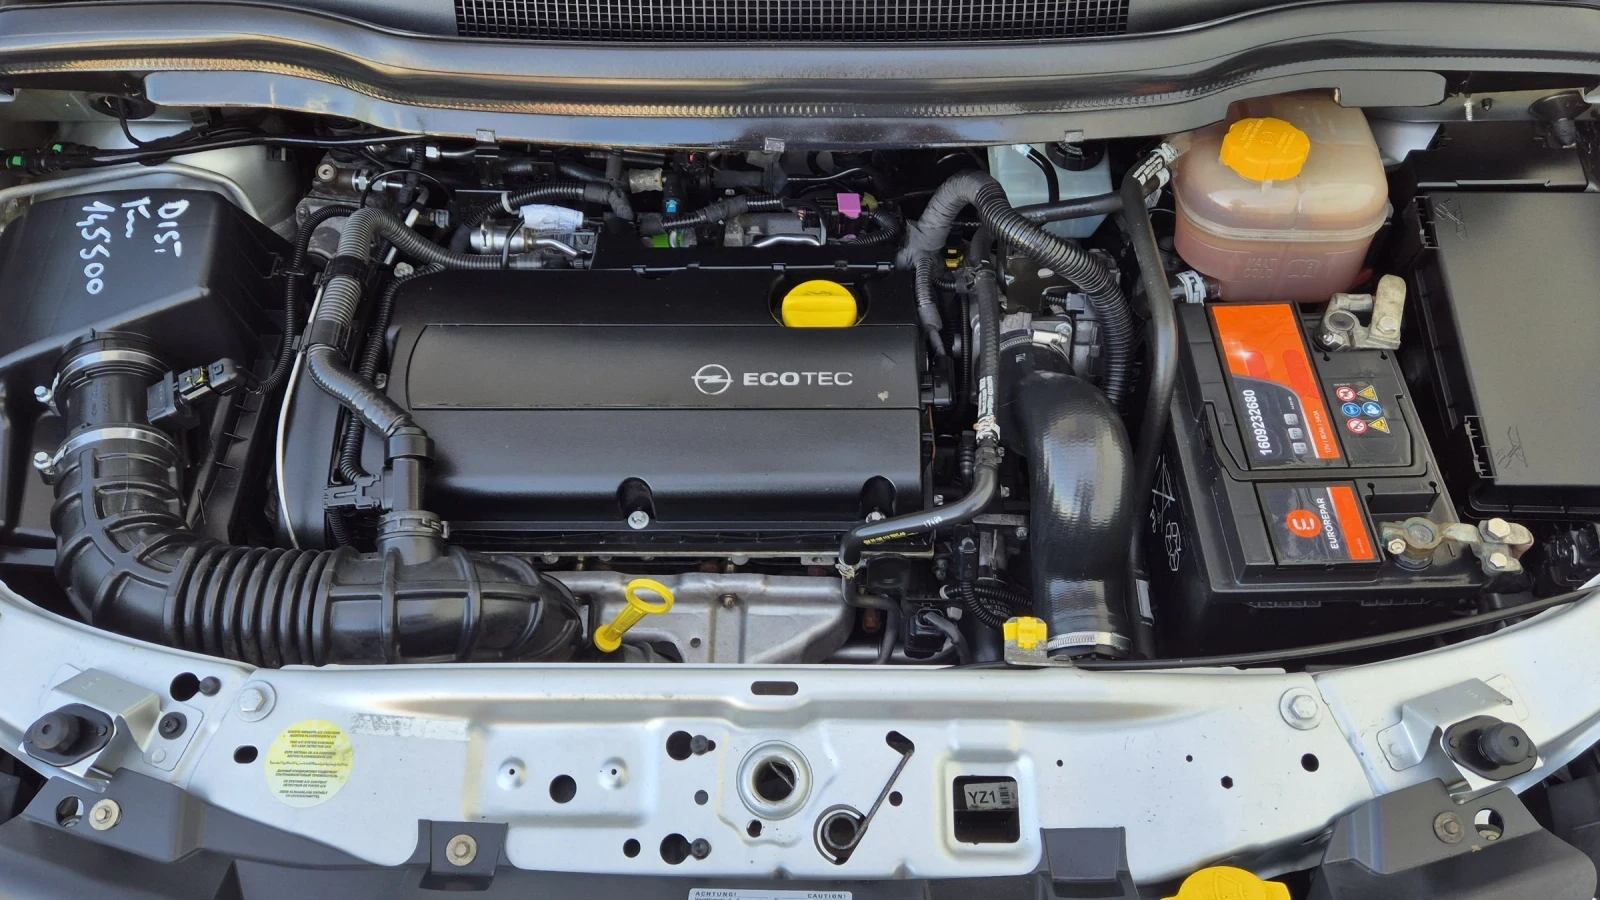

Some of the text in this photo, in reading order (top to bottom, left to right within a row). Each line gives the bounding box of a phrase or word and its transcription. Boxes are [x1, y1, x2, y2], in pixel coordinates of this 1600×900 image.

[743, 371, 853, 386] ECOTEC
[1242, 389, 1273, 456] 1609232680
[1316, 497, 1340, 549] EUROREPAR
[968, 790, 996, 804] YZ1
